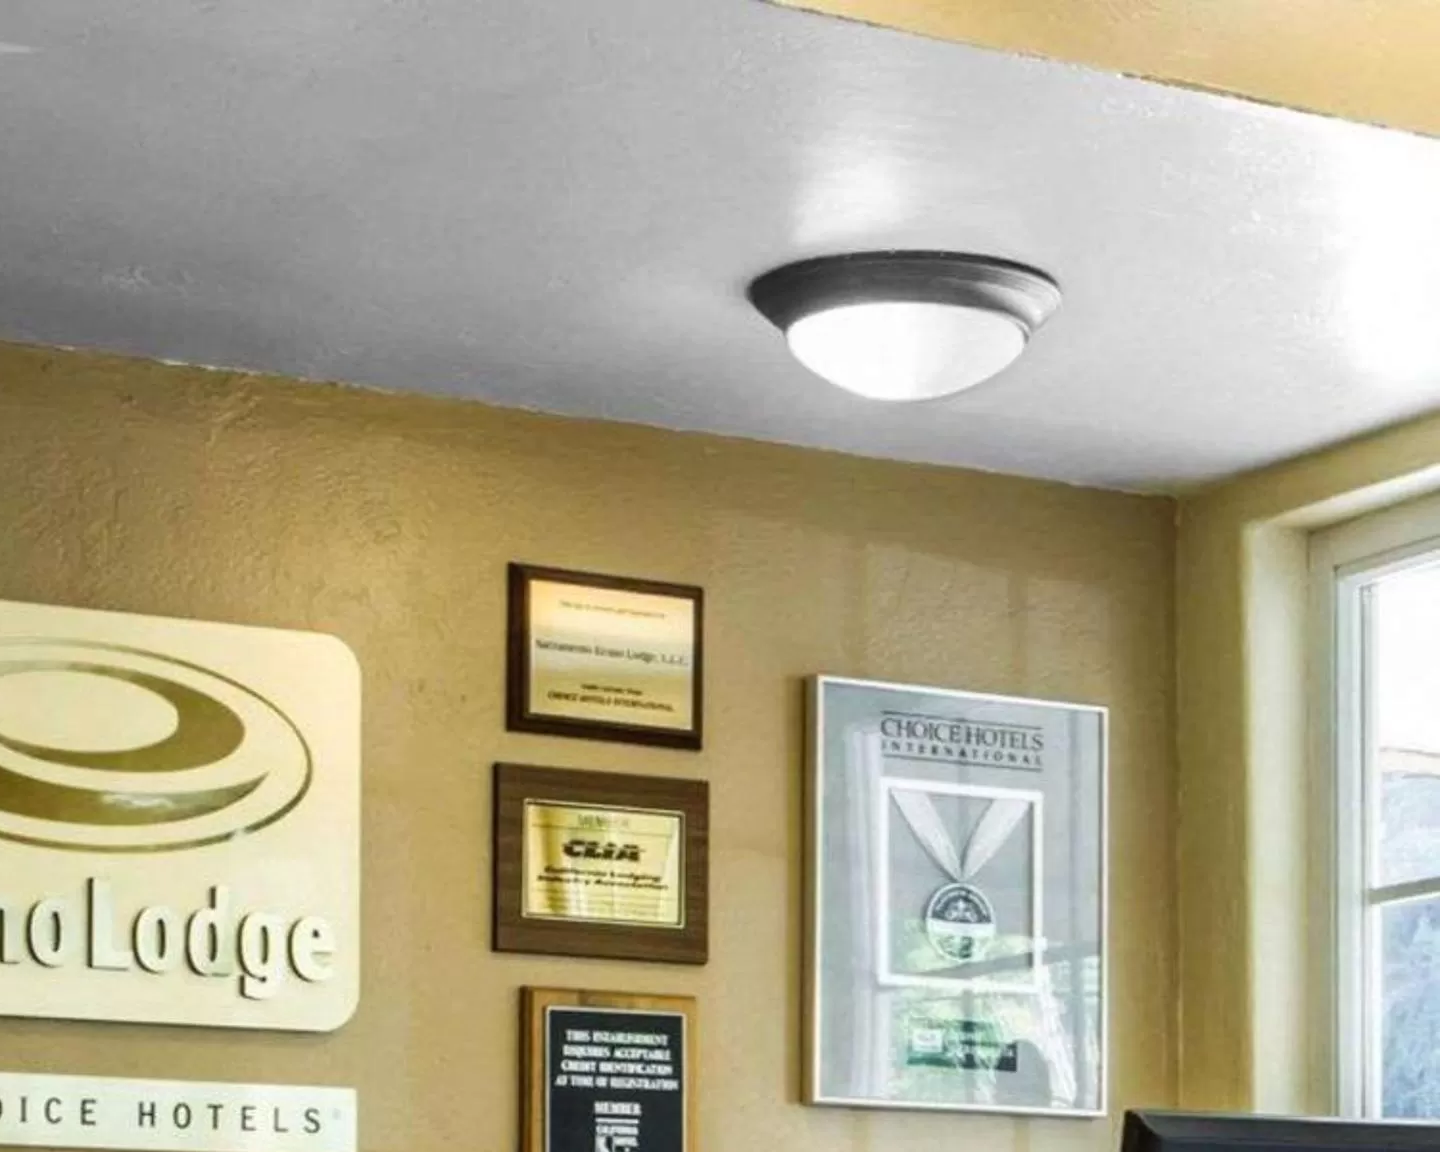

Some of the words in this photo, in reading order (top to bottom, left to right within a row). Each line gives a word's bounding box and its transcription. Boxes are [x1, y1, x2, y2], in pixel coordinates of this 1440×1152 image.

[880, 718, 960, 744] CHOICE
[965, 725, 1044, 750] HOTELS
[881, 739, 1042, 766] INTERNATIONAL
[138, 1101, 322, 1134] HOTELS
[594, 1100, 642, 1115] MEMBER
